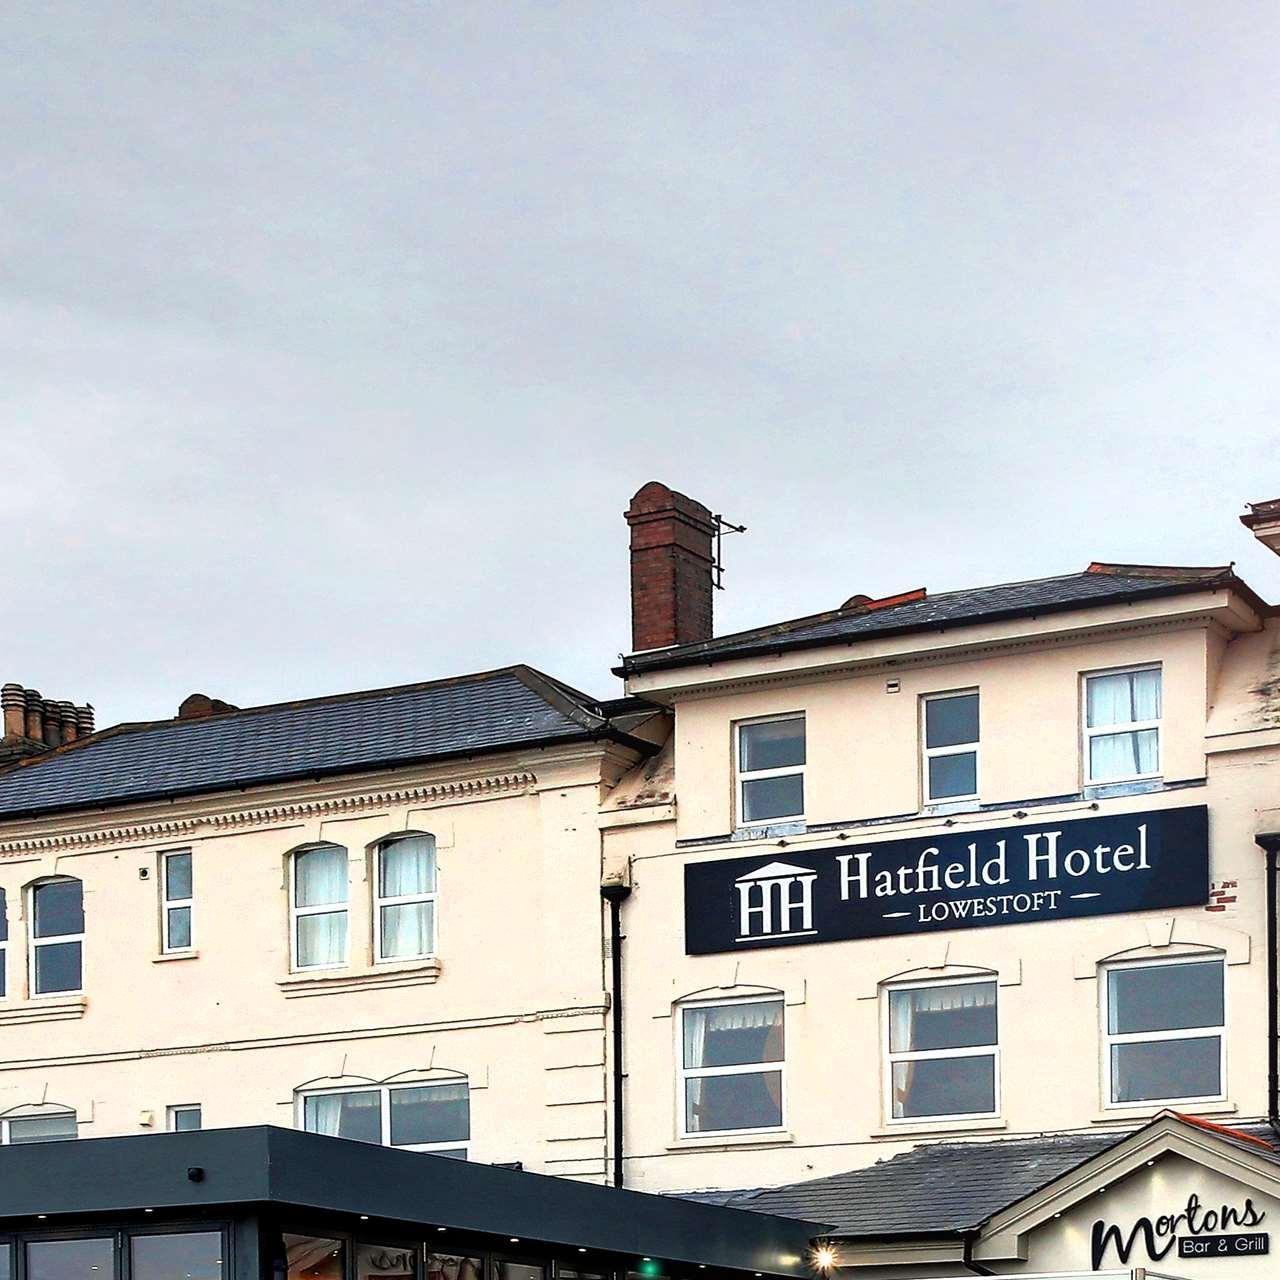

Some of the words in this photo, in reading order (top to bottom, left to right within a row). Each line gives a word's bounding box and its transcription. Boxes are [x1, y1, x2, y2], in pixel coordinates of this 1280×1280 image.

[836, 841, 1010, 901] Hatfield
[1023, 823, 1152, 881] Hotel
[917, 890, 1062, 923] LOWESTOFT
[1091, 1192, 1267, 1272] Mortons
[1182, 1240, 1211, 1254] Bar
[1217, 1238, 1228, 1252] &
[1234, 1236, 1265, 1251] Grill
